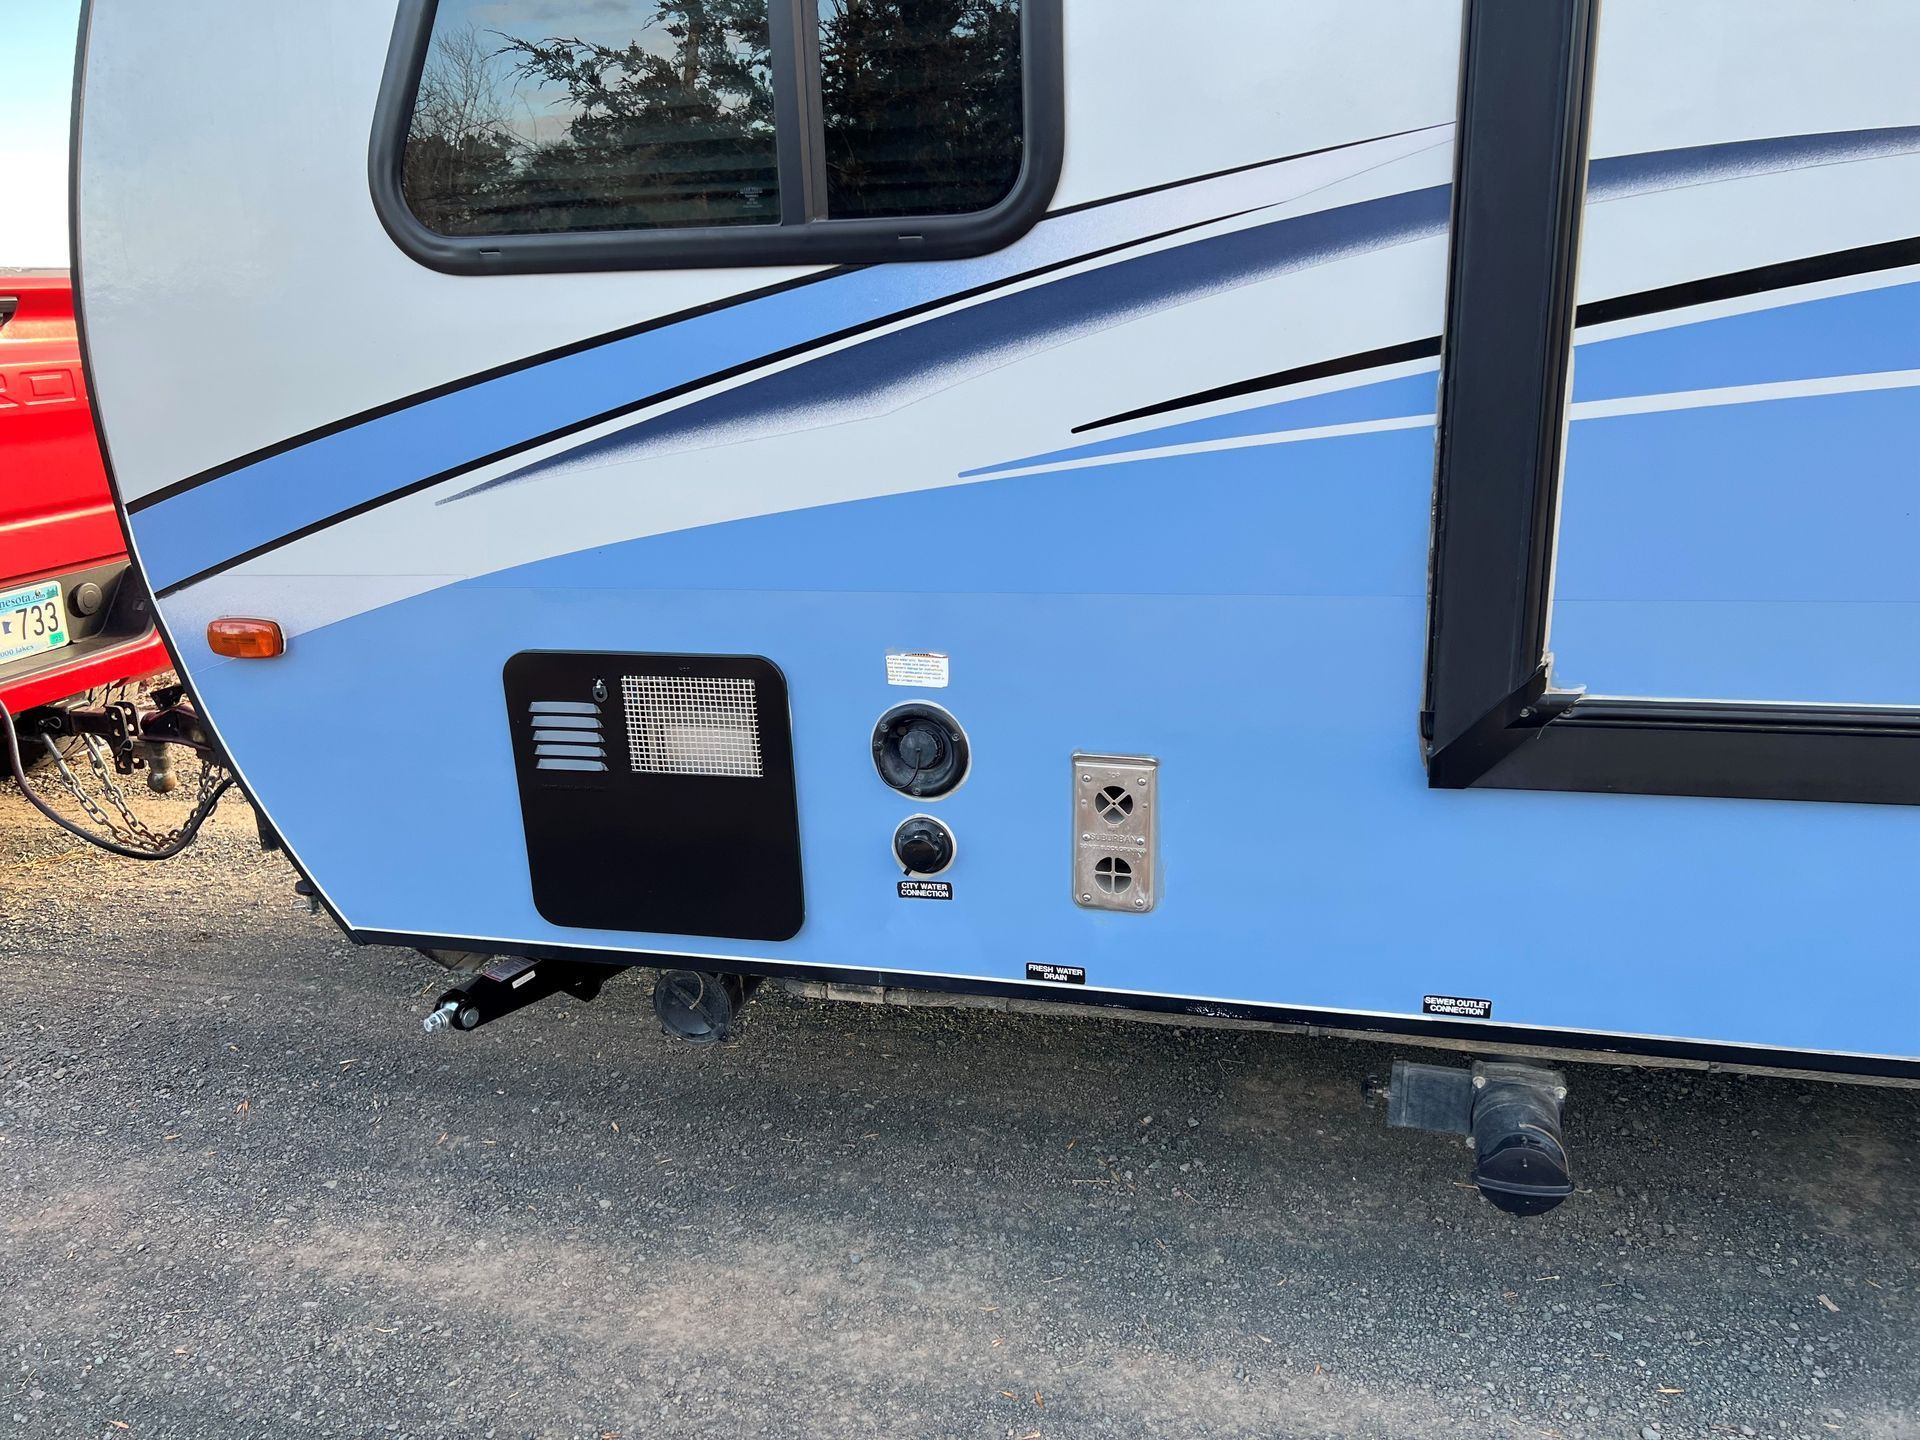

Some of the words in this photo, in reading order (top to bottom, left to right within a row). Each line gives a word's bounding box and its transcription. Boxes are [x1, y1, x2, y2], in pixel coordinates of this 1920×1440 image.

[16, 602, 58, 640] 733
[1090, 832, 1137, 844] SUBURBAN
[901, 889, 949, 897] CONNECTION
[1028, 964, 1053, 972] FRESH
[1056, 967, 1083, 976] WATER
[1043, 973, 1067, 981] DRAIN
[1424, 996, 1455, 1006] SEWER
[1457, 999, 1490, 1009] OUTLET
[1429, 1005, 1484, 1016] CONNECTION
